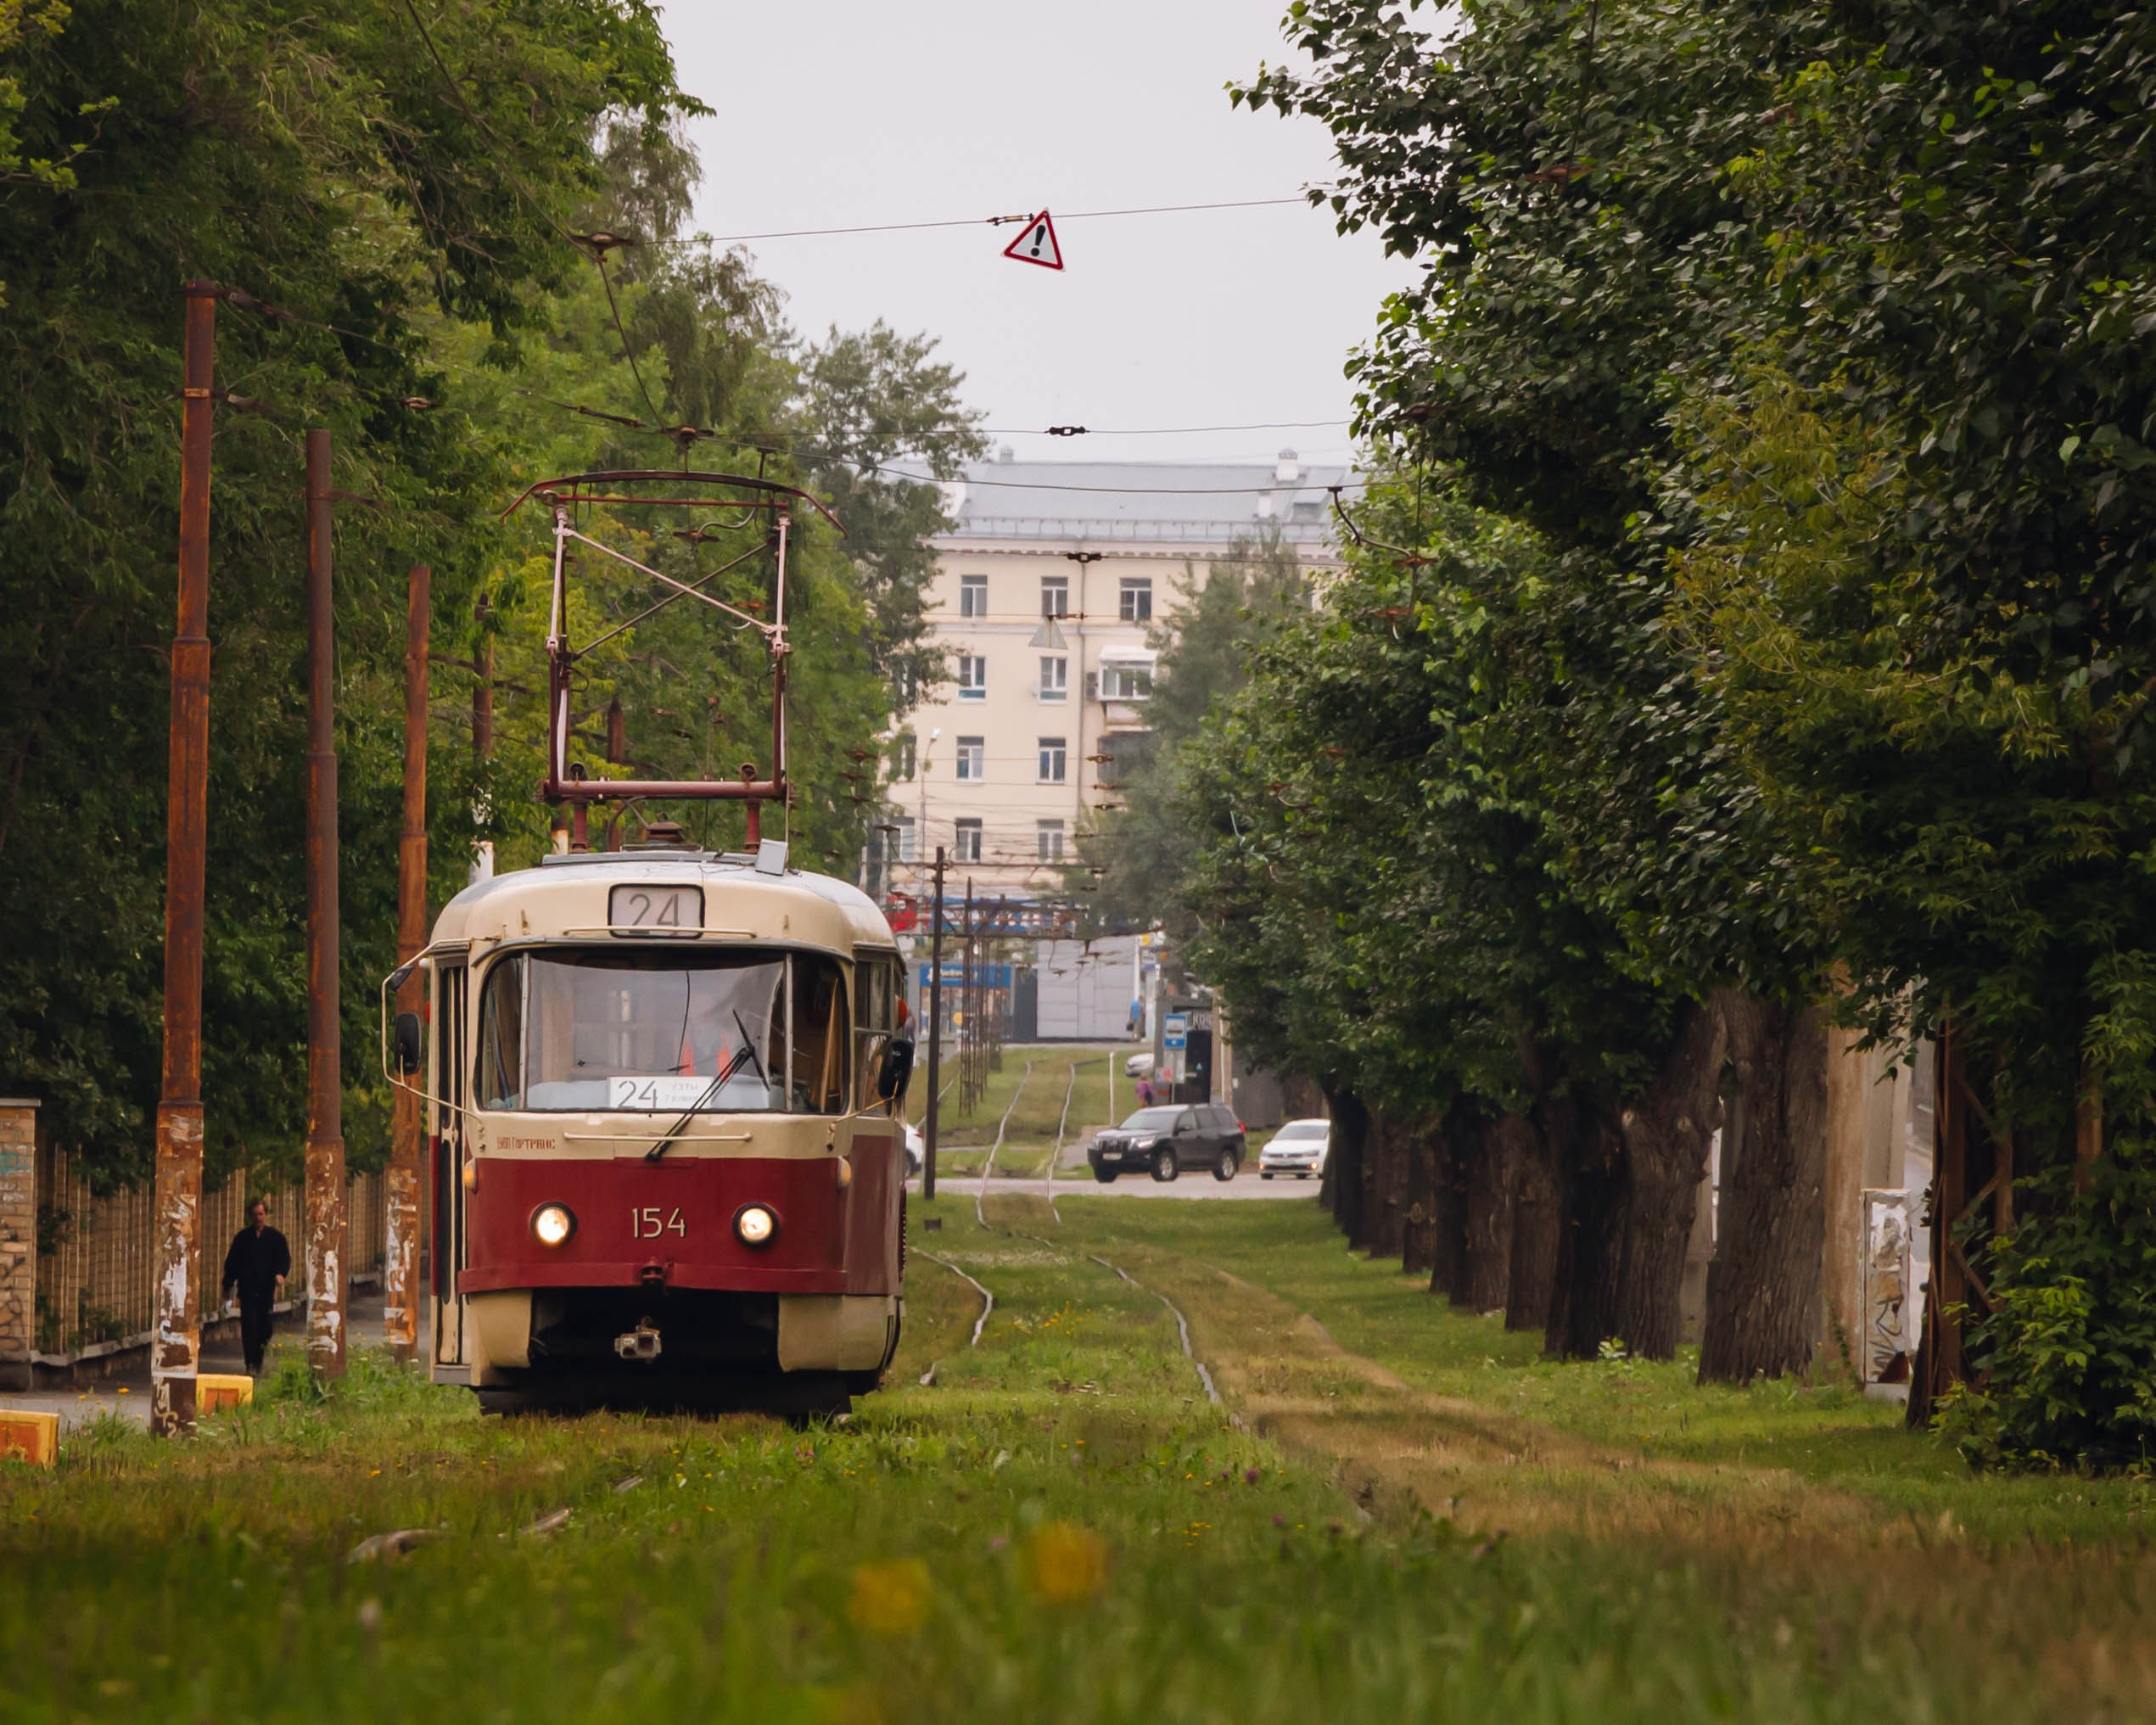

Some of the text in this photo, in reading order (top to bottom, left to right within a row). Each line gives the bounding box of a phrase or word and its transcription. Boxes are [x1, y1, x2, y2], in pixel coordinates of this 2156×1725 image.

[629, 893, 680, 936] 24
[618, 1080, 658, 1108] 24
[632, 1207, 686, 1238] 154
